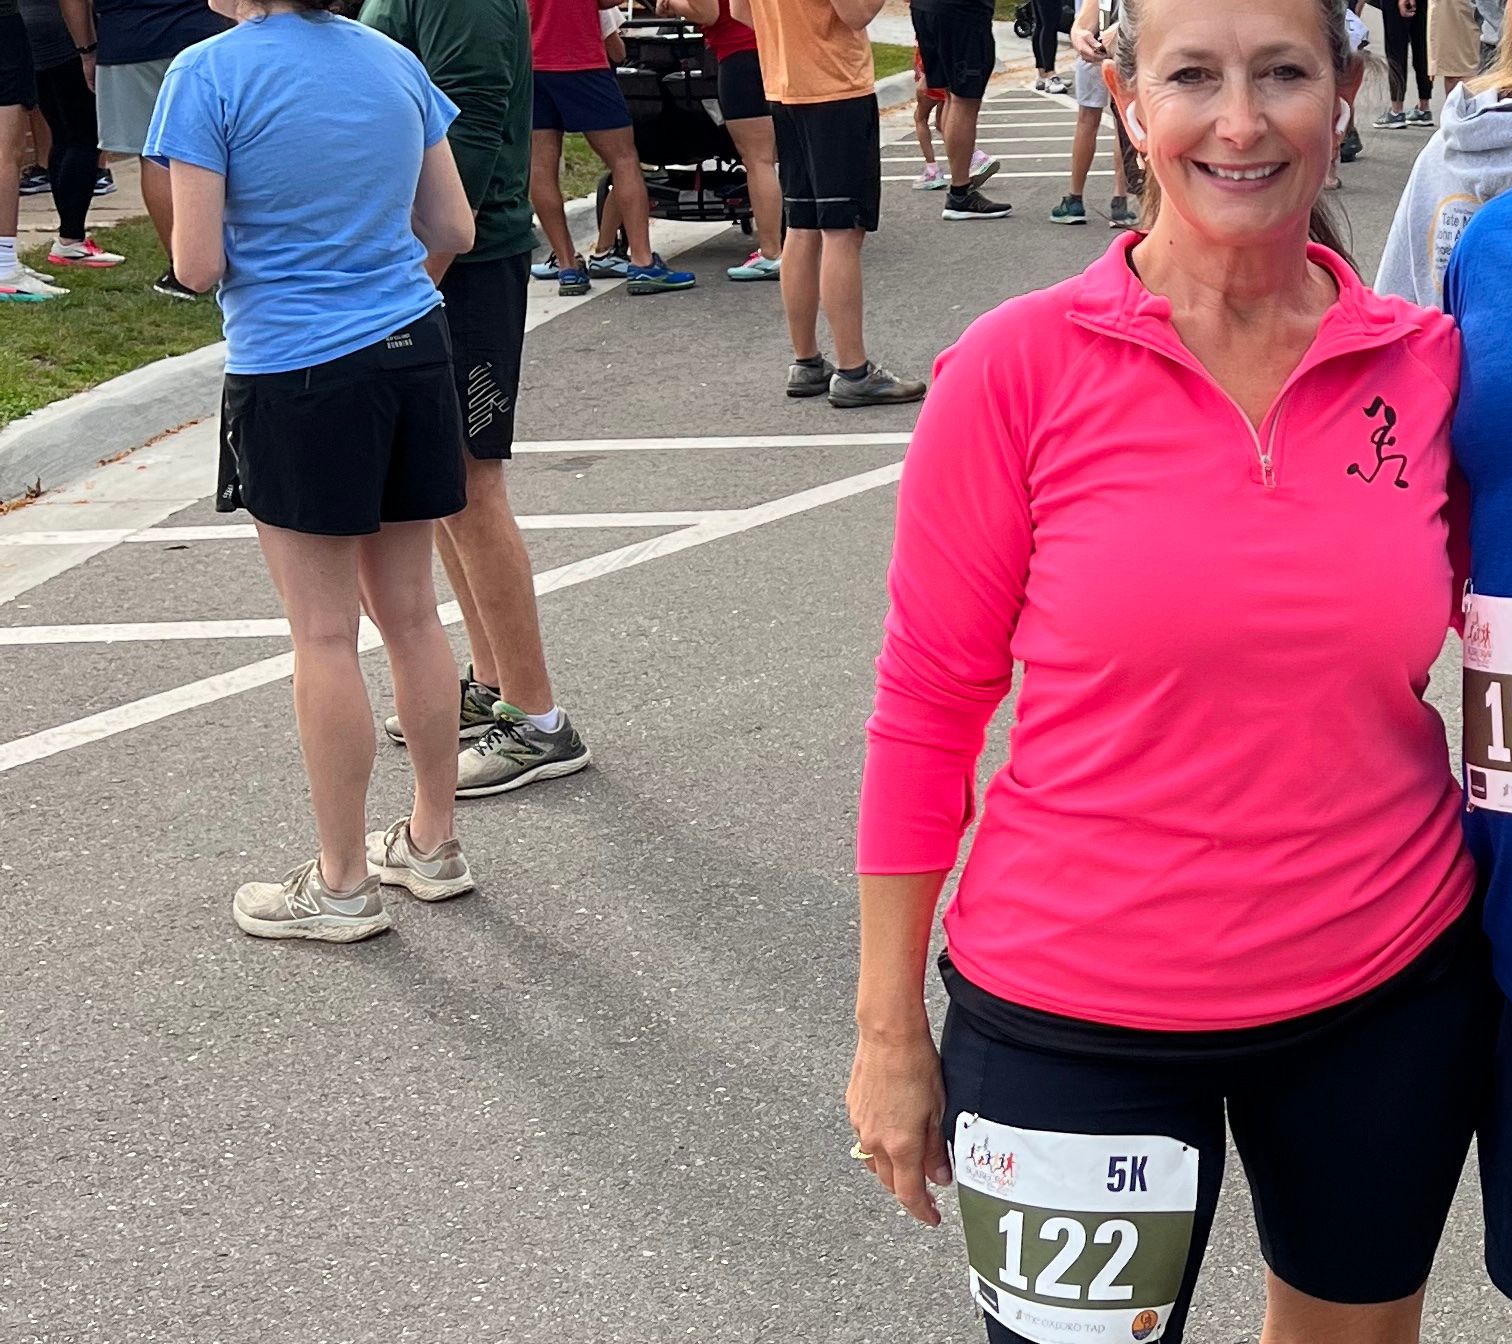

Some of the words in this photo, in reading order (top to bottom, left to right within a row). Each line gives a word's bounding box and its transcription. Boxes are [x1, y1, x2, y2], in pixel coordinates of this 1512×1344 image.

[1443, 213, 1459, 227] Tate
[1106, 1156, 1148, 1192] 5K
[999, 1209, 1139, 1301] 122
